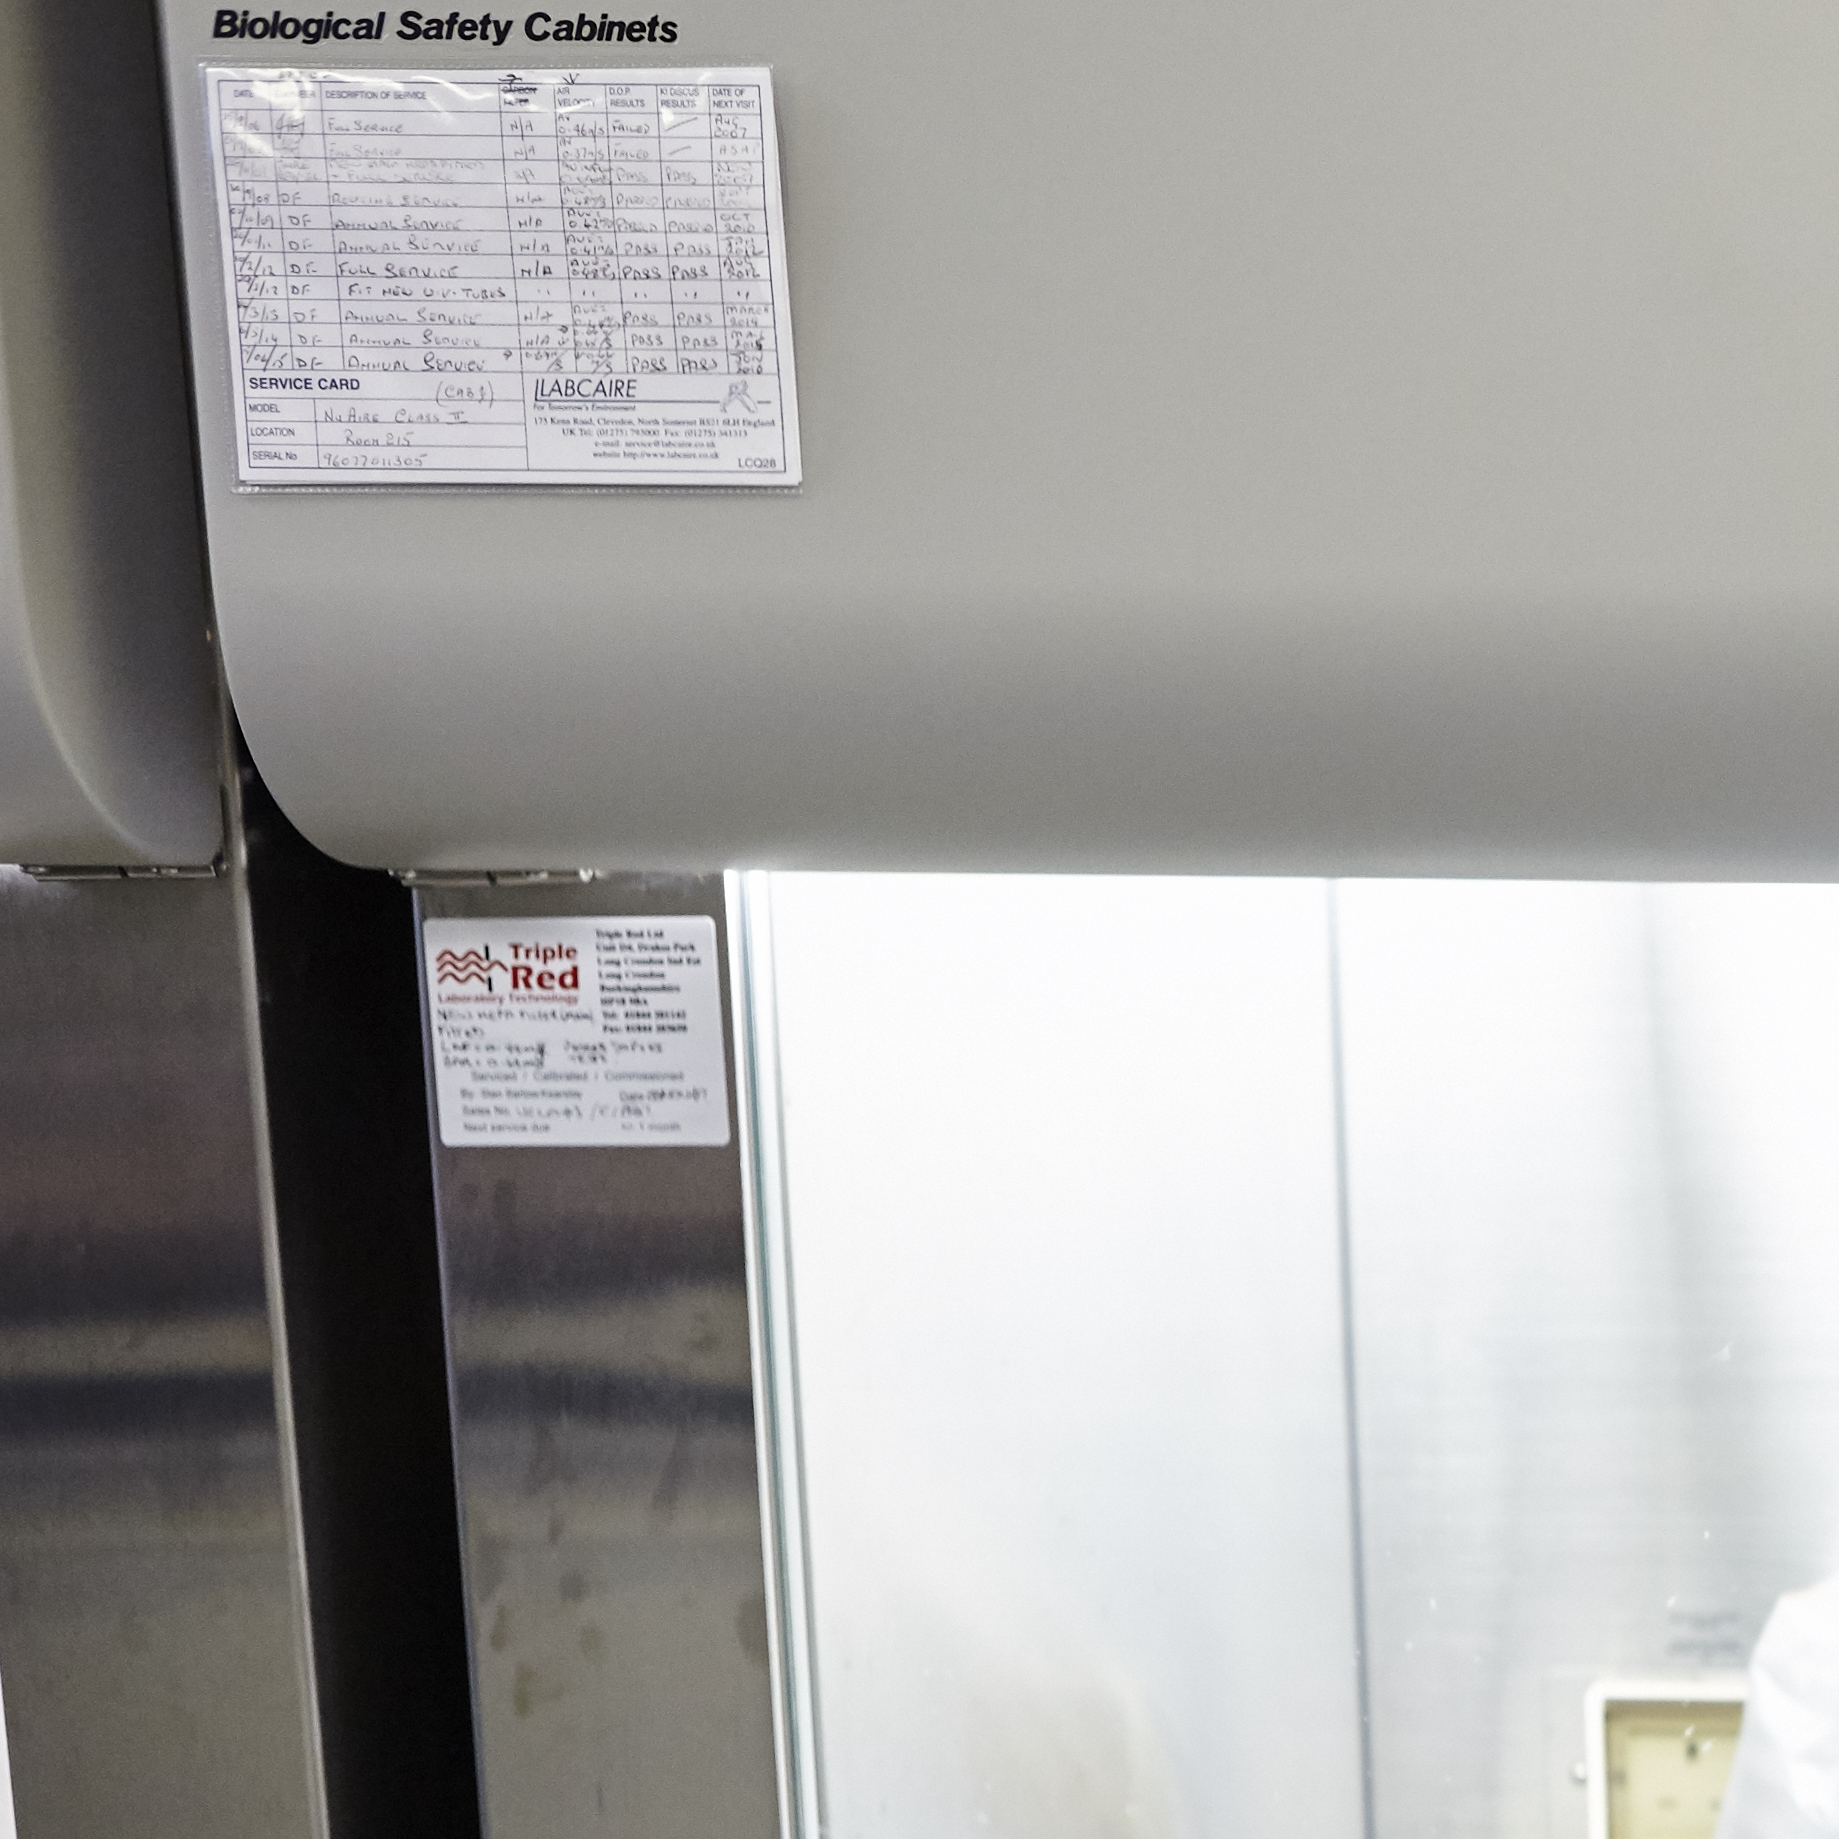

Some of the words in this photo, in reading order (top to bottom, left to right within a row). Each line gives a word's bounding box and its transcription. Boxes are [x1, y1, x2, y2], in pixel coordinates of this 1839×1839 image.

[213, 10, 386, 44] Biological
[396, 11, 513, 46] Safety
[523, 12, 679, 43] Cabinets
[326, 91, 378, 99] DESCRIPTION
[380, 91, 391, 99] OF
[394, 91, 426, 99] SERVICE
[669, 88, 699, 96] DISCUS
[713, 88, 731, 96] DATE
[735, 88, 744, 96] OF
[713, 100, 734, 108] NEXT
[736, 100, 755, 108] VISIT
[250, 379, 313, 390] SERVICE
[318, 379, 360, 390] CARD
[535, 379, 637, 400] LABCAIRE
[249, 404, 280, 413] MODEL
[638, 418, 659, 426] North
[251, 428, 295, 437] LOCATION
[252, 452, 282, 460] SERIAL
[509, 942, 577, 964] Triple
[512, 966, 579, 990] Red
[437, 993, 504, 1006] Laboratory
[509, 993, 578, 1005] Technology
